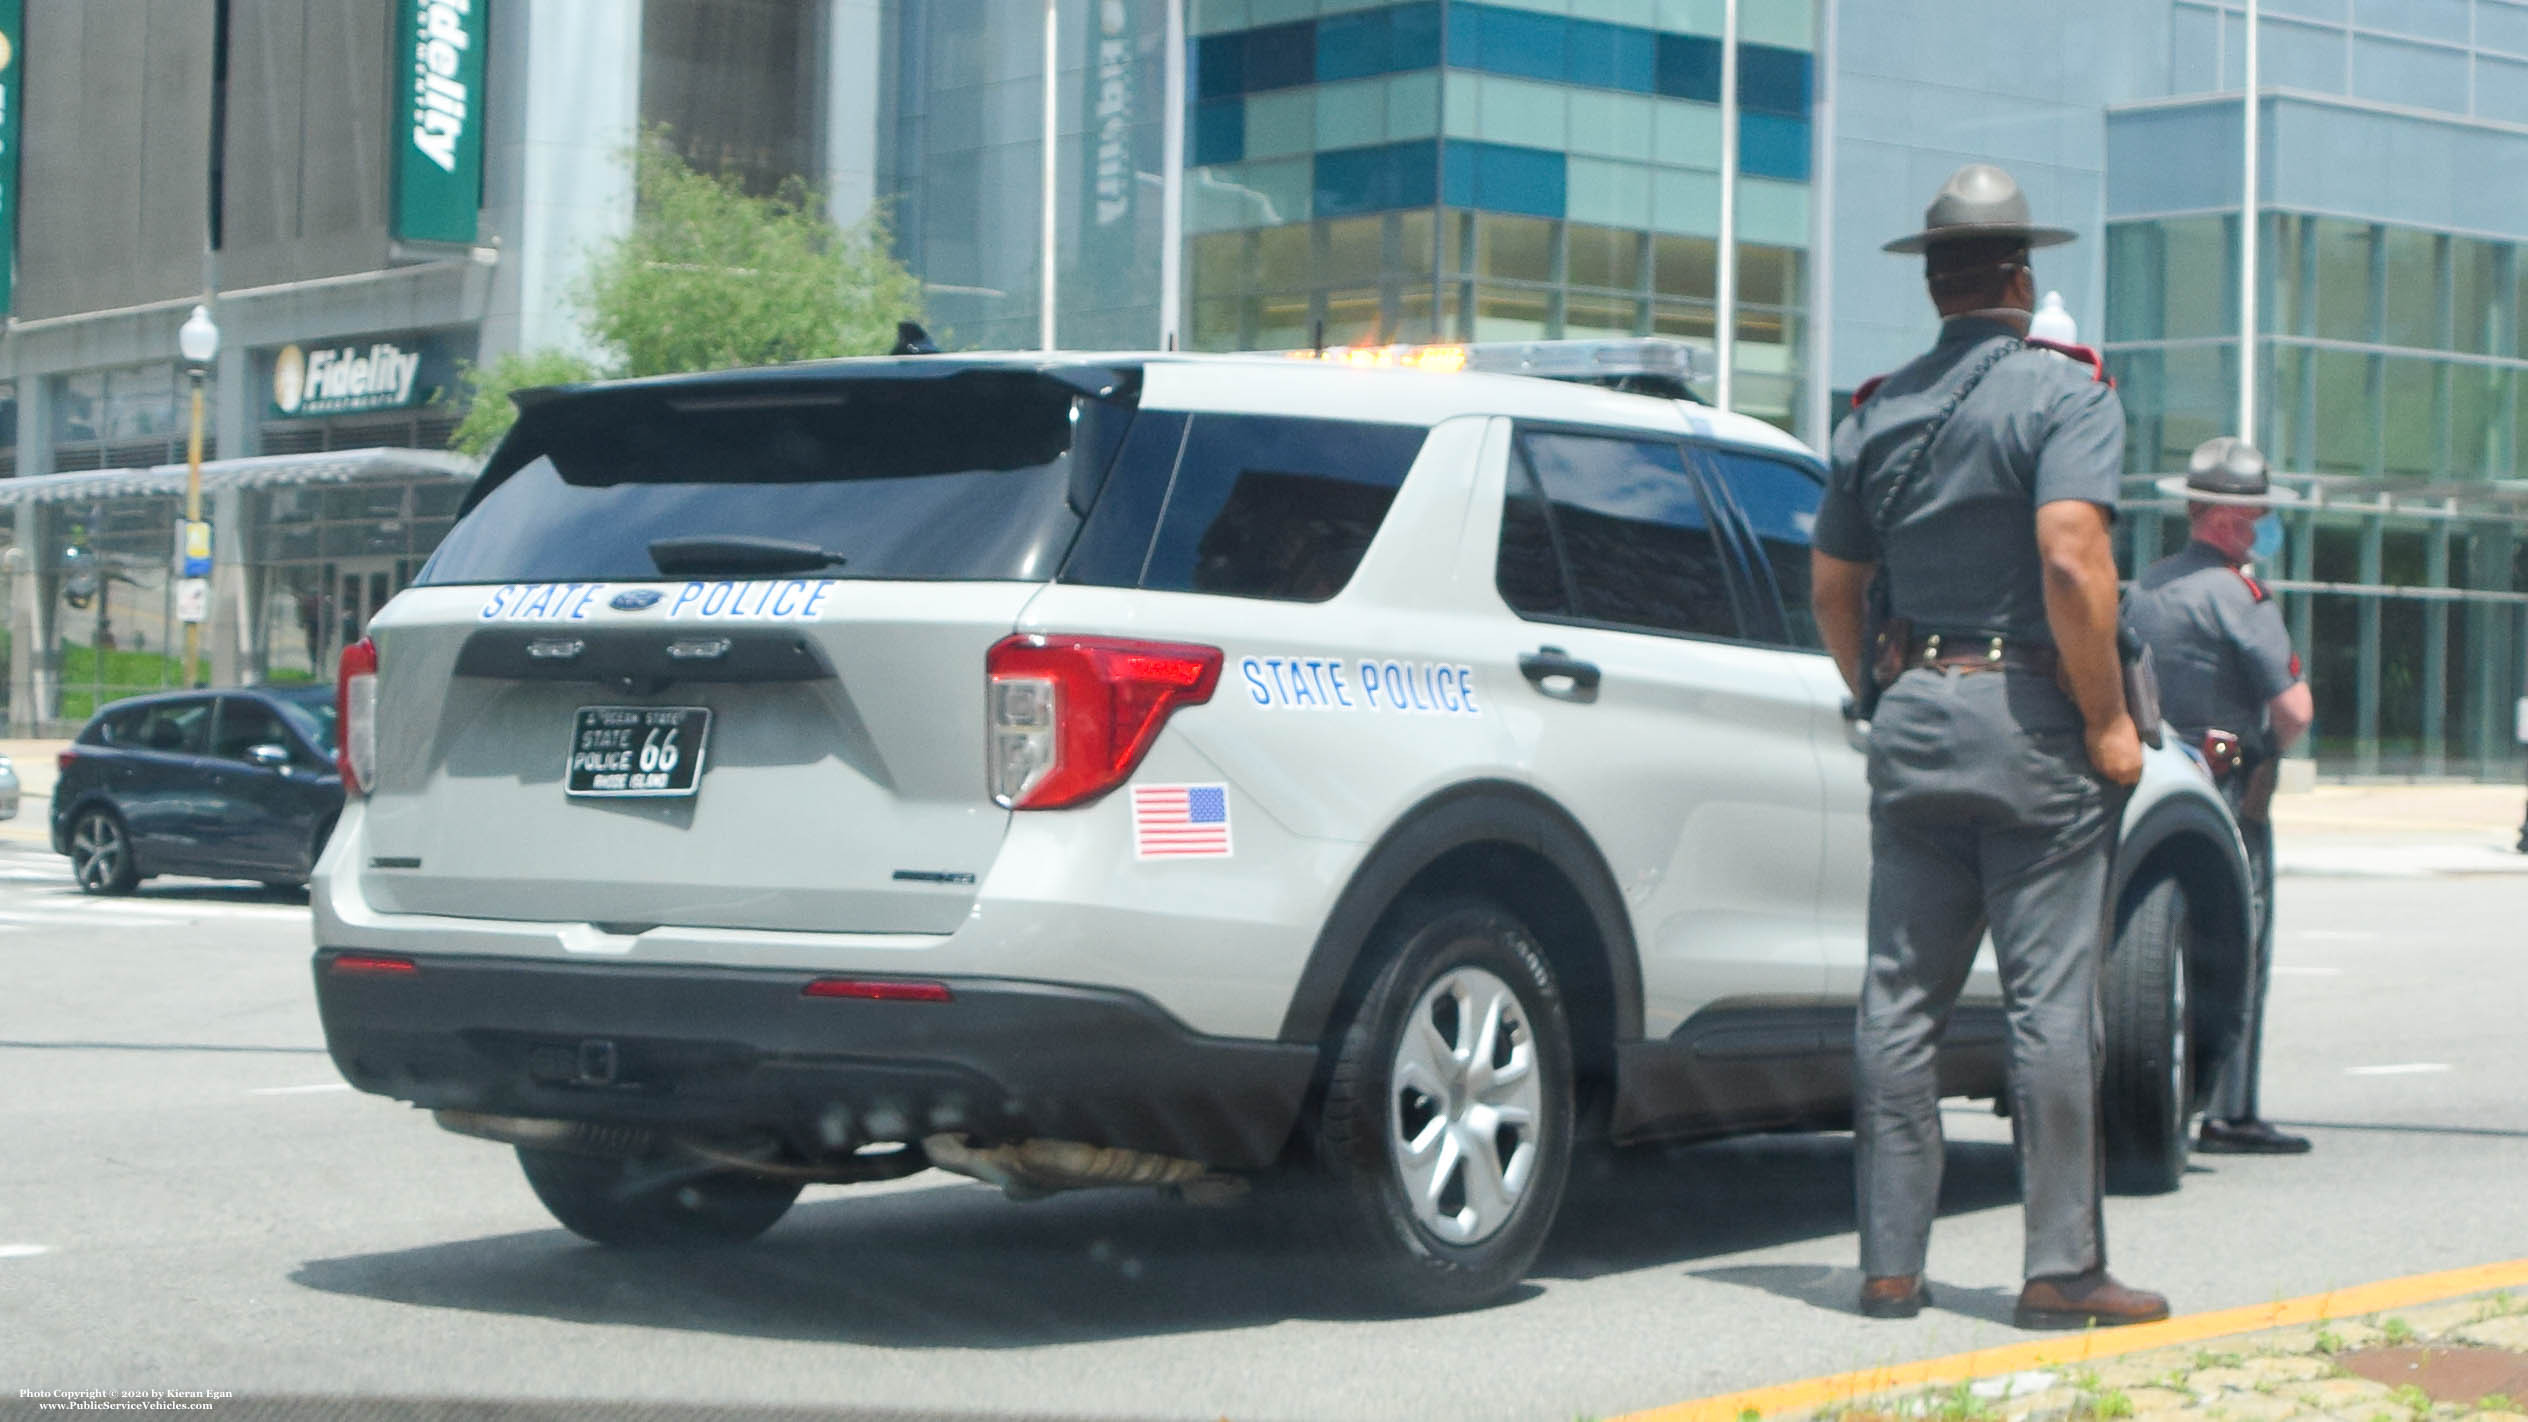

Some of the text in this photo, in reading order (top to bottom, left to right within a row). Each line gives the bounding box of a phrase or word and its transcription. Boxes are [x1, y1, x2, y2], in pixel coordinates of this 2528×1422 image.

[304, 343, 419, 404] Fidelity
[483, 583, 604, 619] STATE
[669, 580, 834, 617] POLICE
[1243, 660, 1478, 712] STATE POLICE
[581, 728, 632, 749] STATE
[639, 727, 679, 772] 66
[573, 750, 632, 771] POLICE
